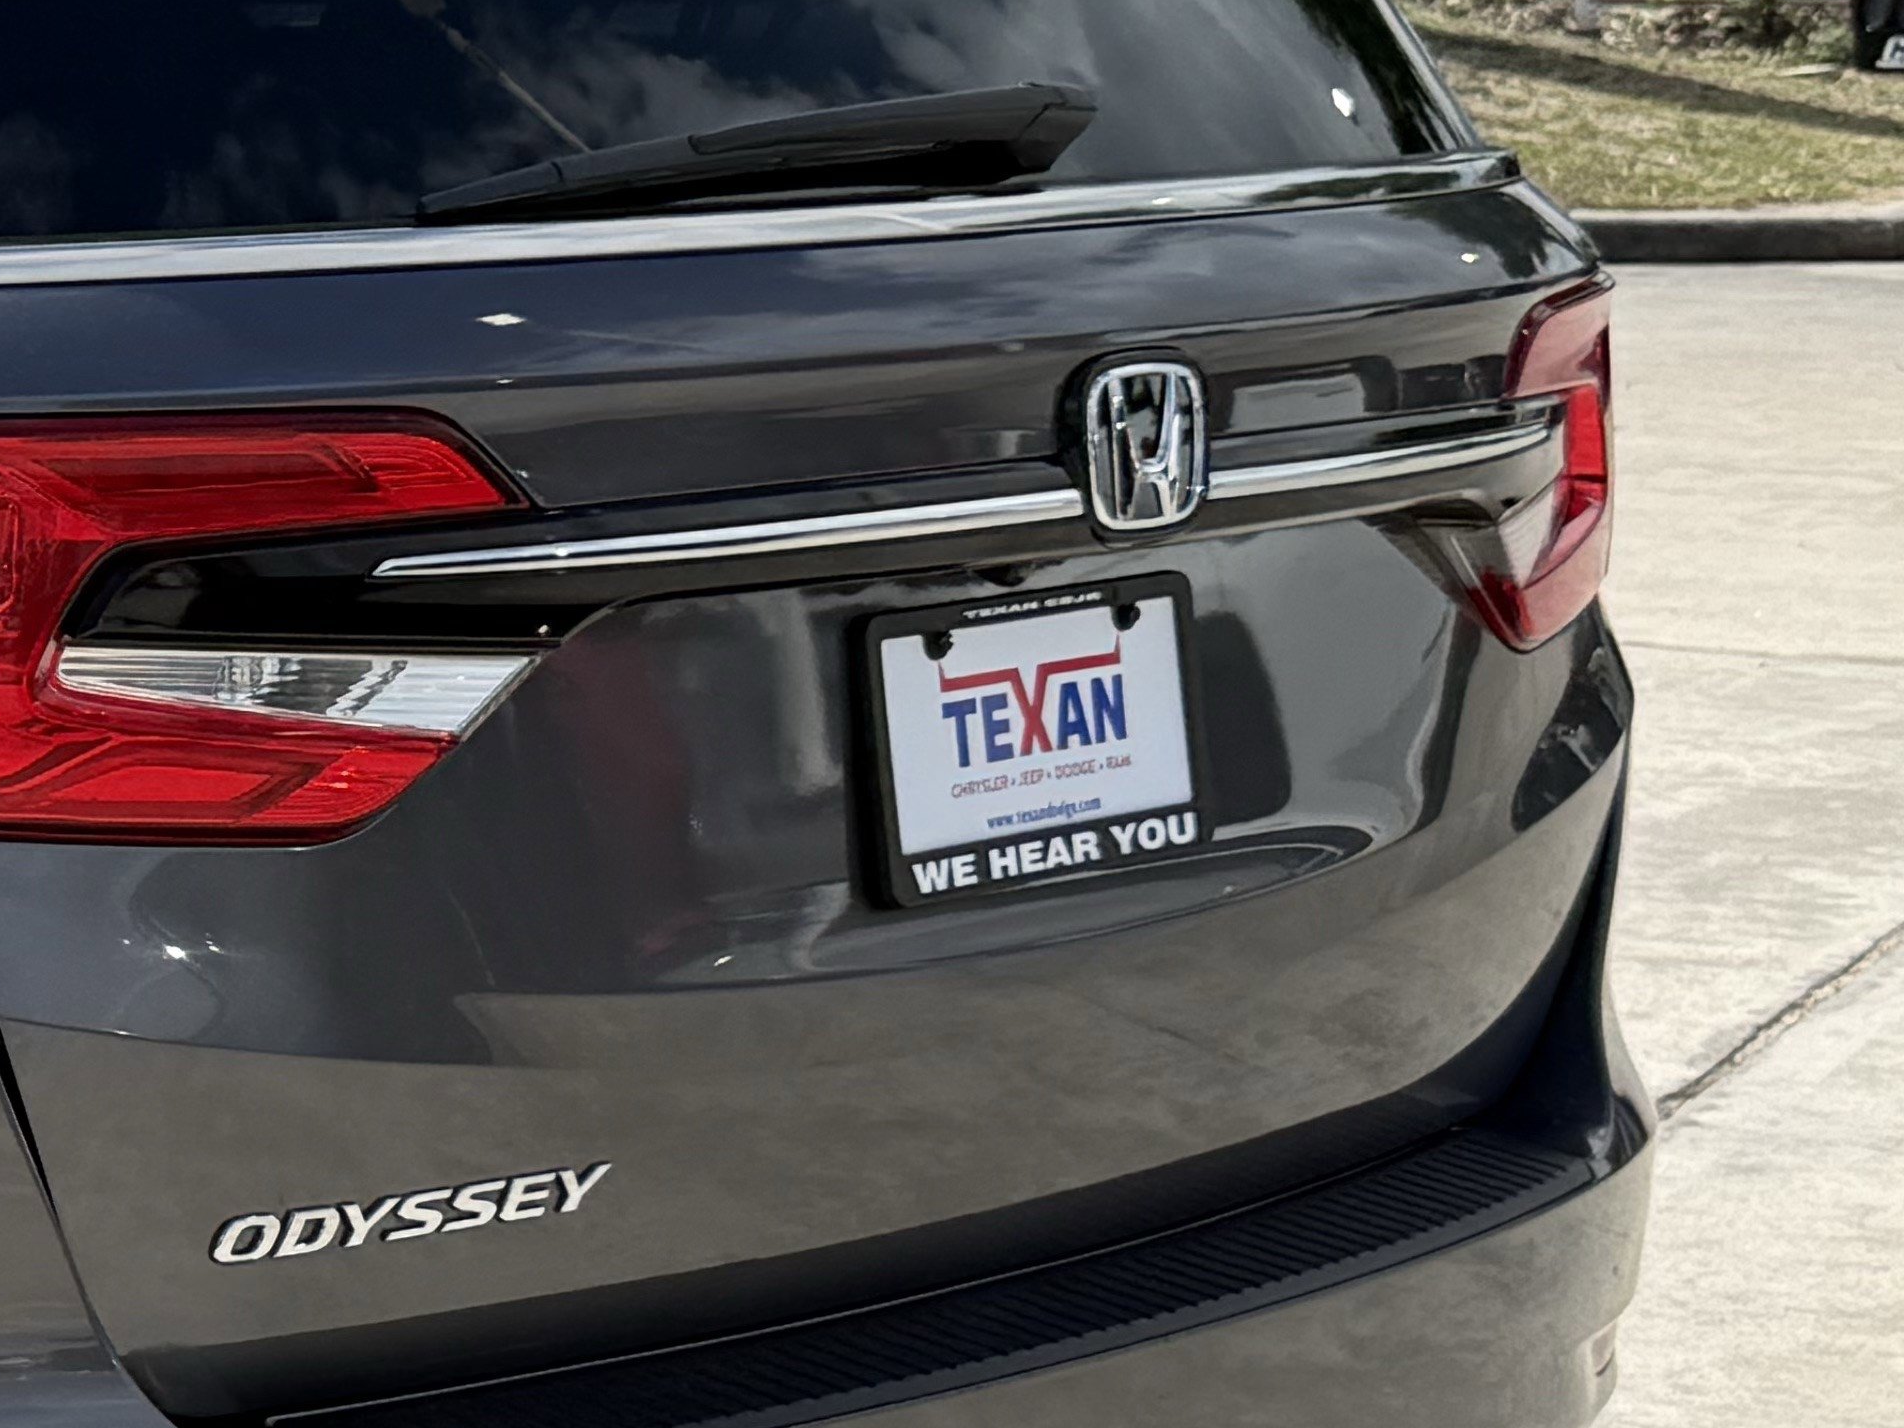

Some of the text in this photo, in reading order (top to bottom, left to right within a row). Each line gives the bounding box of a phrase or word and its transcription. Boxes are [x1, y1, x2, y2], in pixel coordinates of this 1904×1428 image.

[962, 600, 1039, 619] TEXAN
[940, 652, 1128, 769] TEXAN
[912, 812, 1198, 894] WE HEAR YOU
[209, 1161, 613, 1264] ODYSSEY
